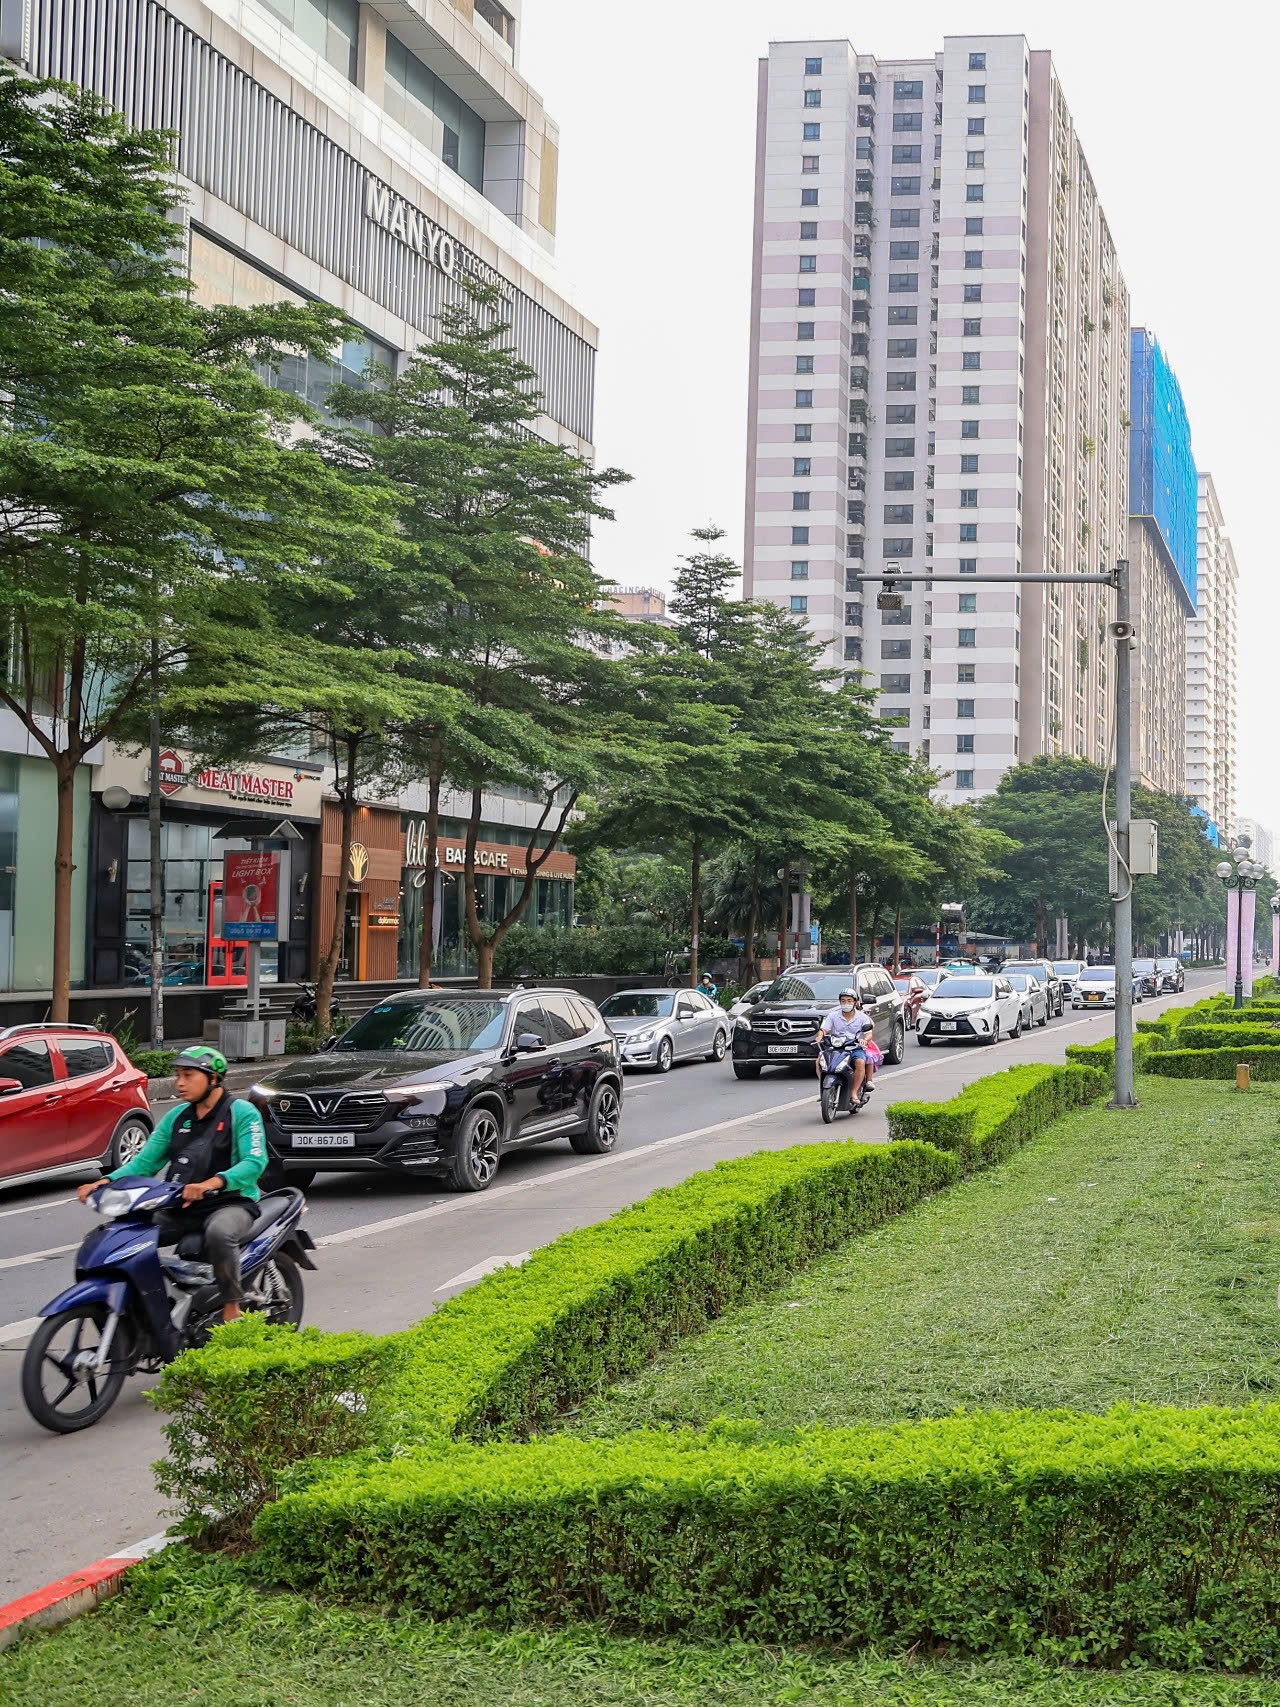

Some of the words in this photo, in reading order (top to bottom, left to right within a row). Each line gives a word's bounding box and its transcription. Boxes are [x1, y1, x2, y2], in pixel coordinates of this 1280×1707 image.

[366, 177, 454, 275] MANYO
[198, 769, 239, 791] MEAT
[241, 774, 294, 799] MASTER
[231, 869, 254, 878] LIGHT
[297, 1135, 349, 1146] 30K-867.06
